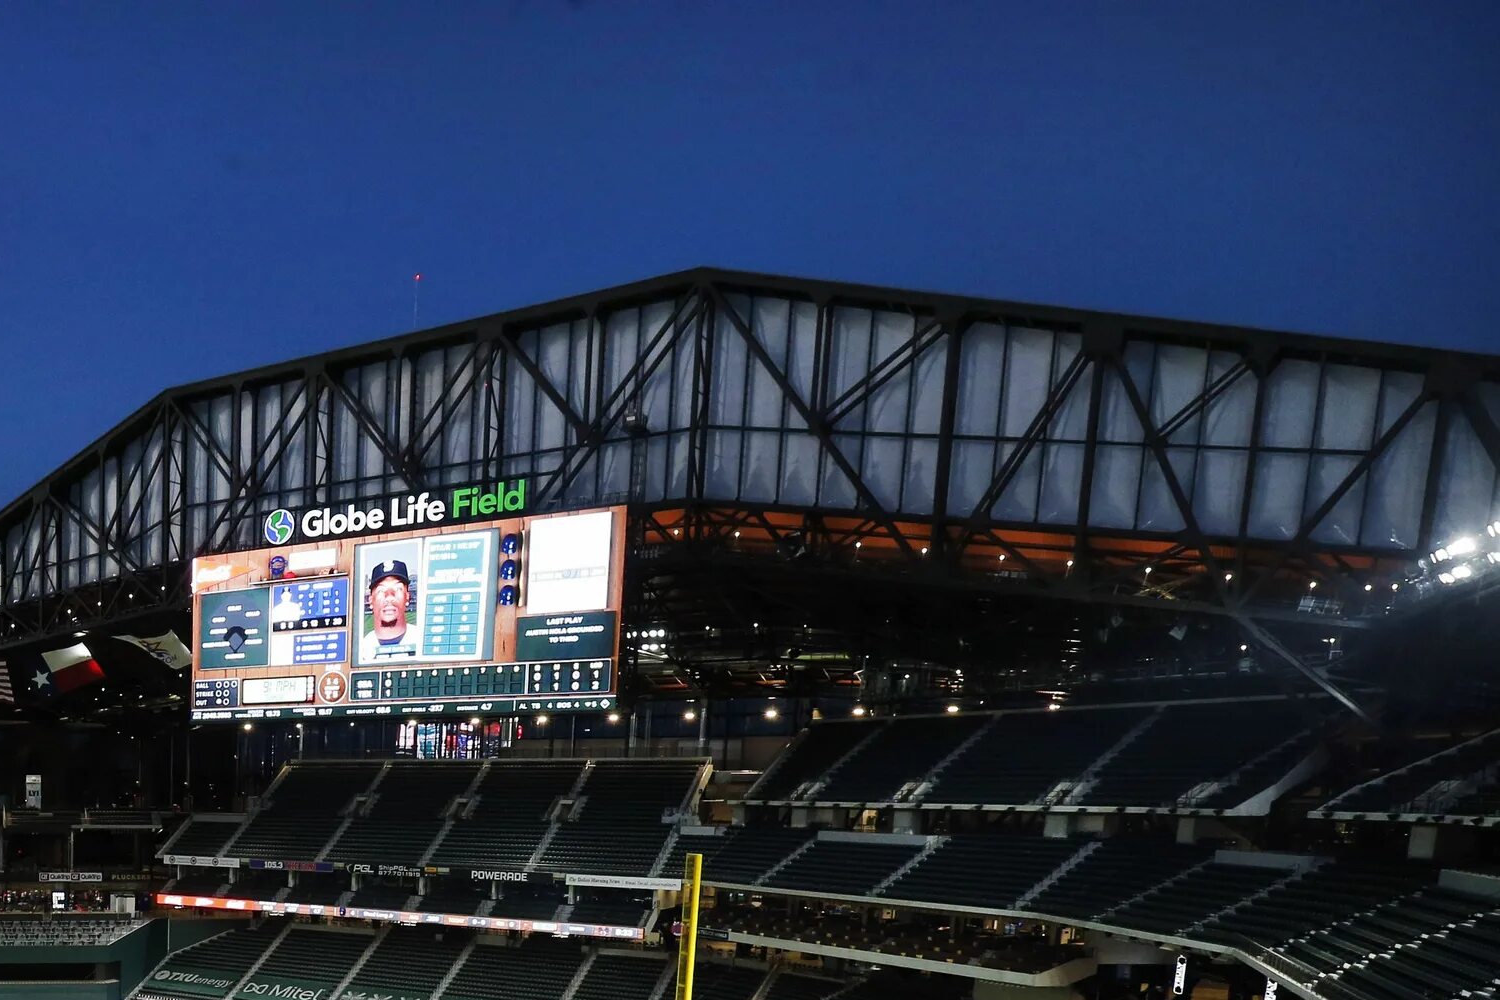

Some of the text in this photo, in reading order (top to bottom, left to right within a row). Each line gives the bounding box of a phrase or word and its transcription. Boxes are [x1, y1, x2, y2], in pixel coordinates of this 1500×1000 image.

[301, 479, 526, 538] Globe Life Field
[547, 617, 564, 625] LAST
[275, 680, 297, 690] MPH
[264, 861, 284, 869] 105.3
[353, 864, 375, 873] PGL
[471, 870, 529, 882] POWERADE
[269, 984, 322, 1000] Mitel
